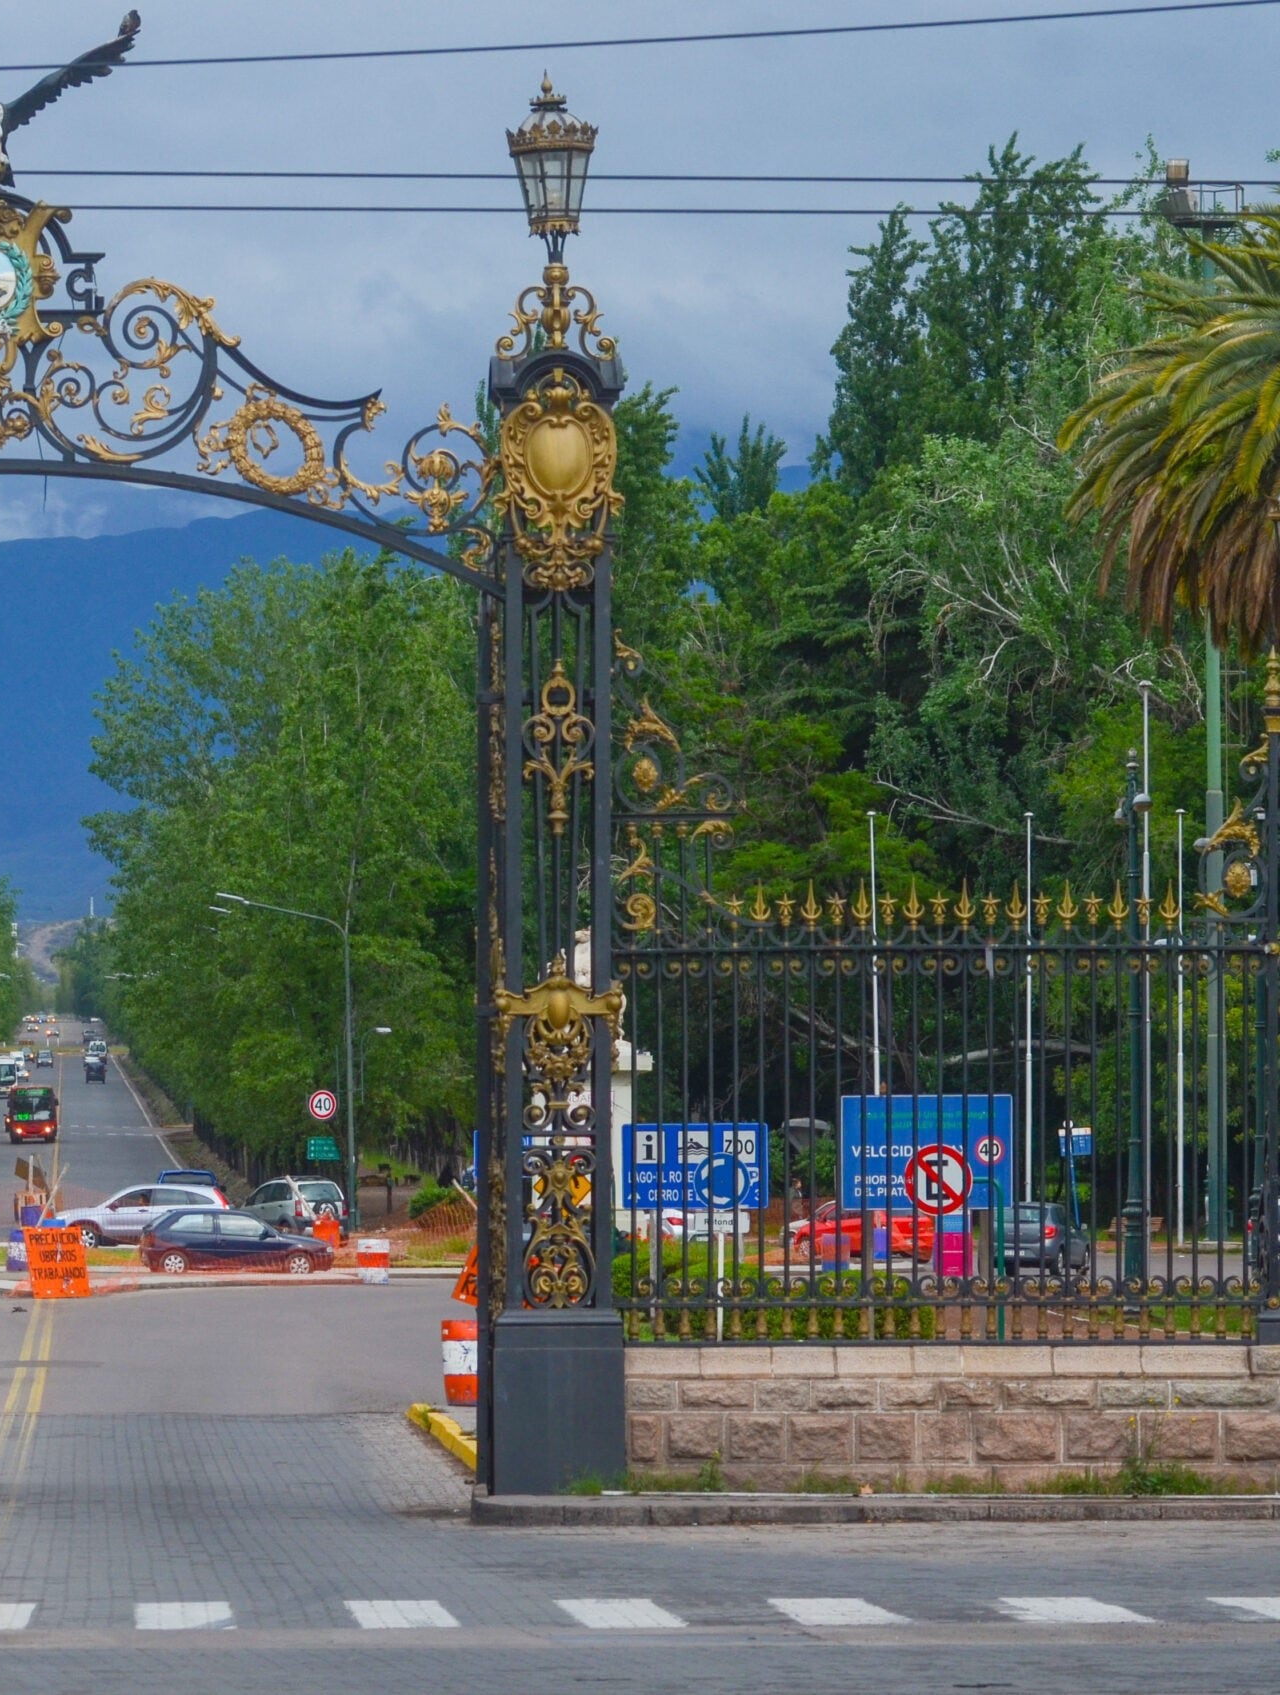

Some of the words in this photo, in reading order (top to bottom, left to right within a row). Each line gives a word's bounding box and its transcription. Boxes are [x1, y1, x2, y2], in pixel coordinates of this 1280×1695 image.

[315, 1097, 331, 1111] 40
[979, 1143, 1000, 1157] 40
[704, 1218, 735, 1226] Rtond
